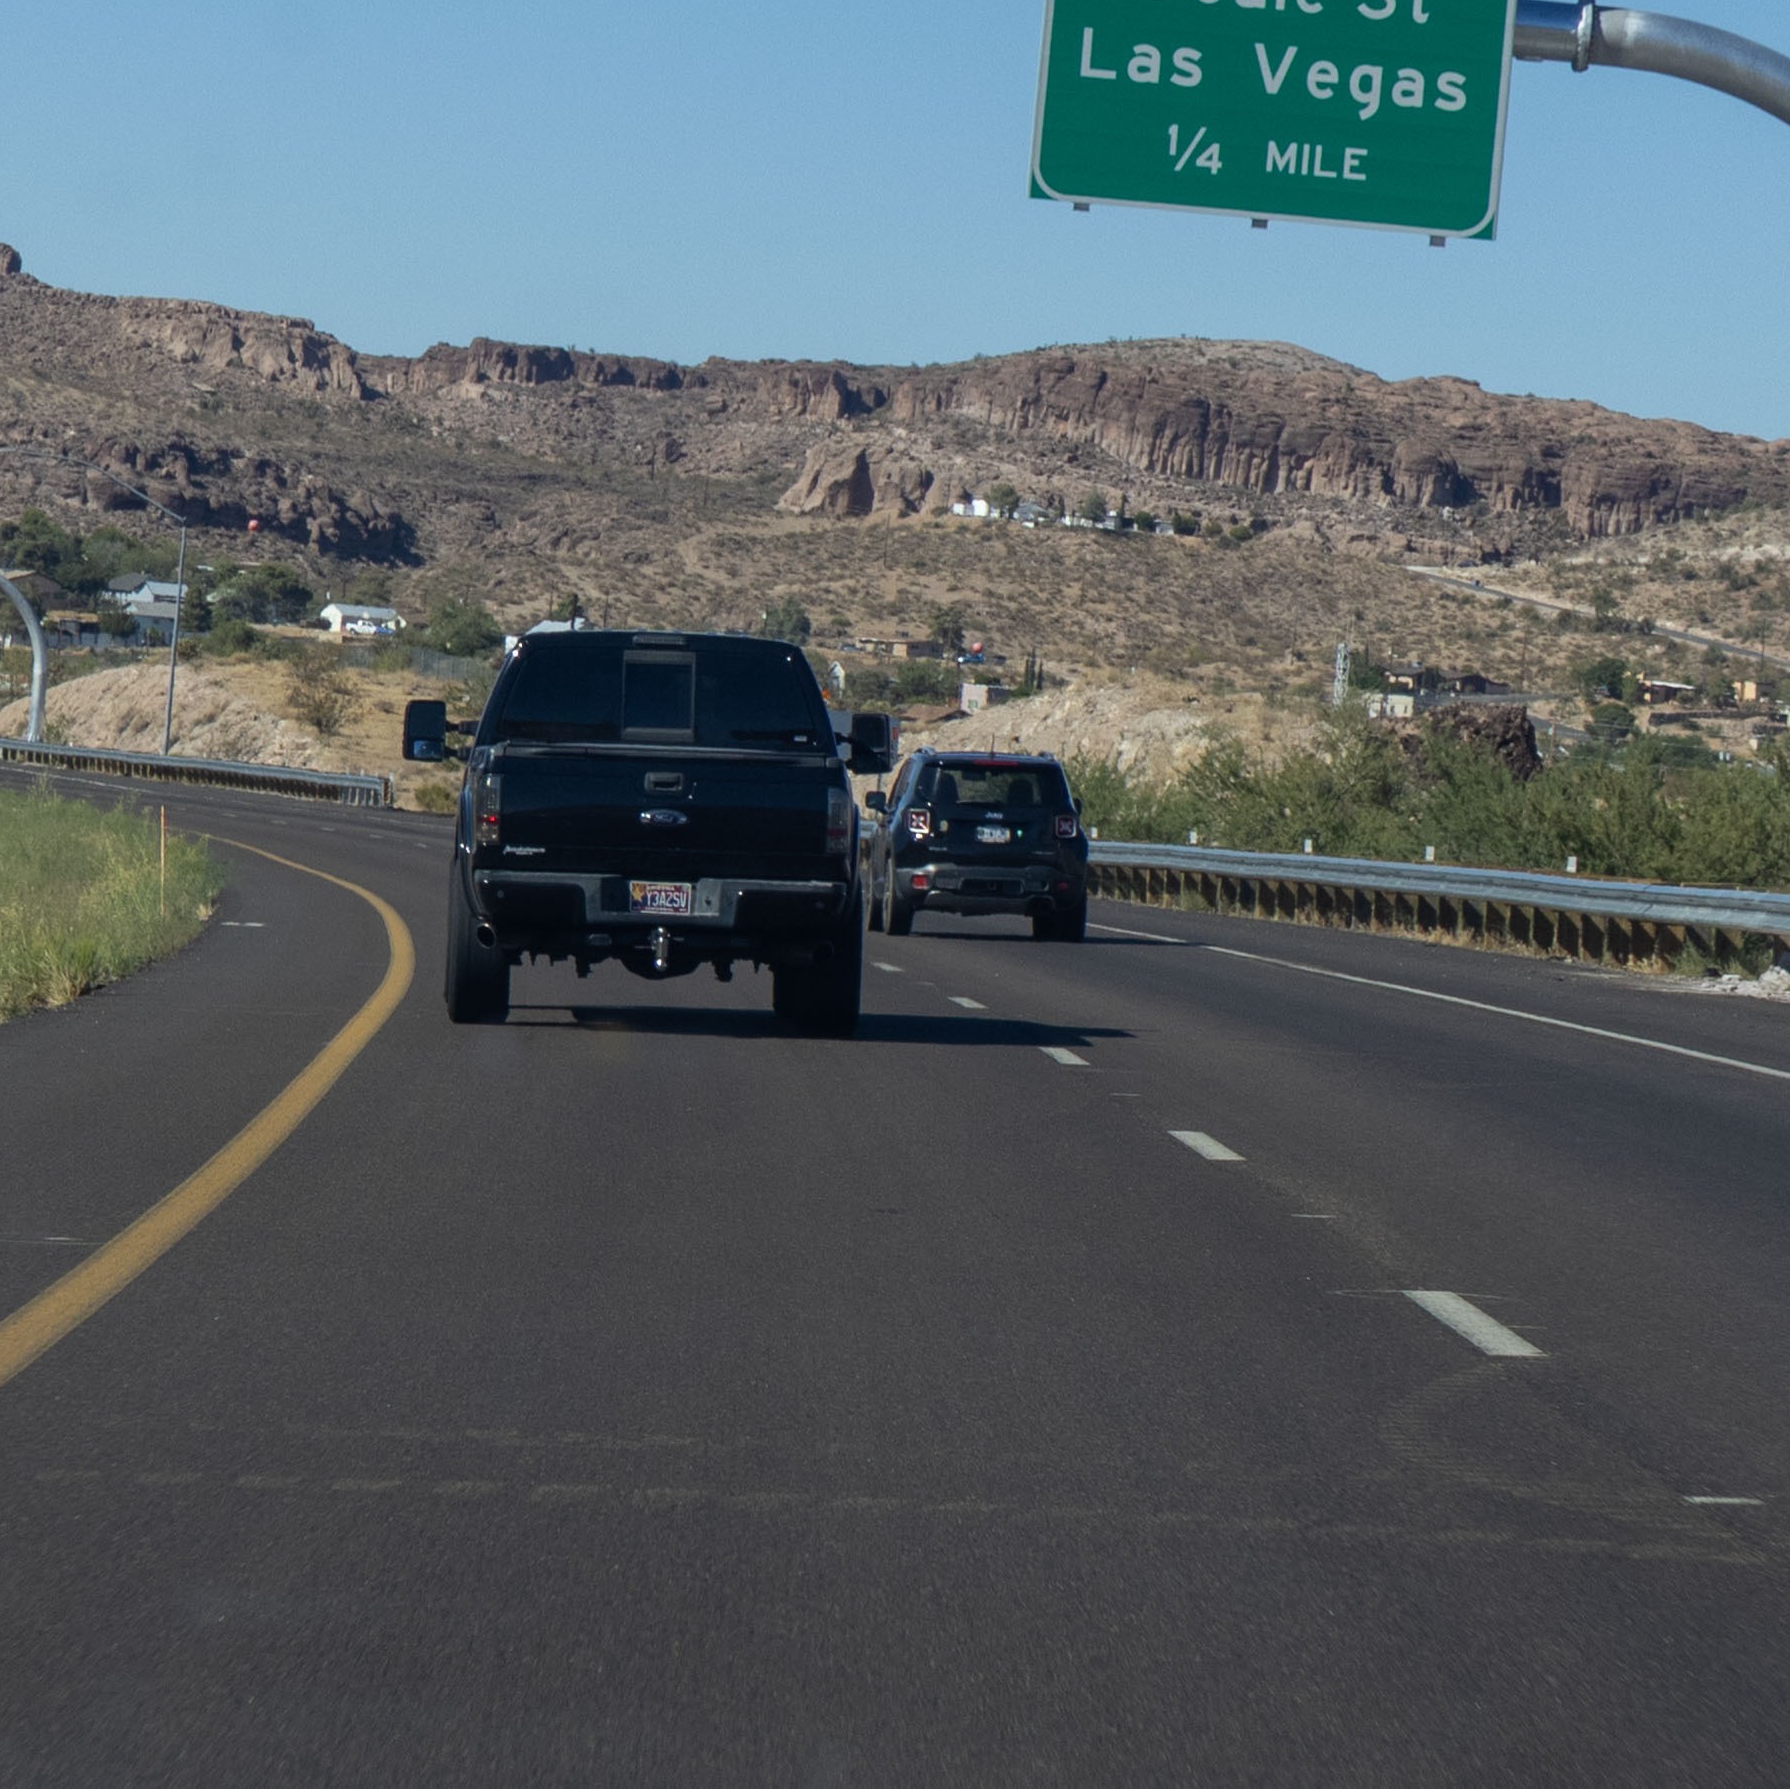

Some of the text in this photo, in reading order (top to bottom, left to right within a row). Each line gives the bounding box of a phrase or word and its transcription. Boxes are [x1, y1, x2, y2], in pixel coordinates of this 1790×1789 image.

[1080, 27, 1467, 121] Las Vegas
[1265, 140, 1368, 181] MILE
